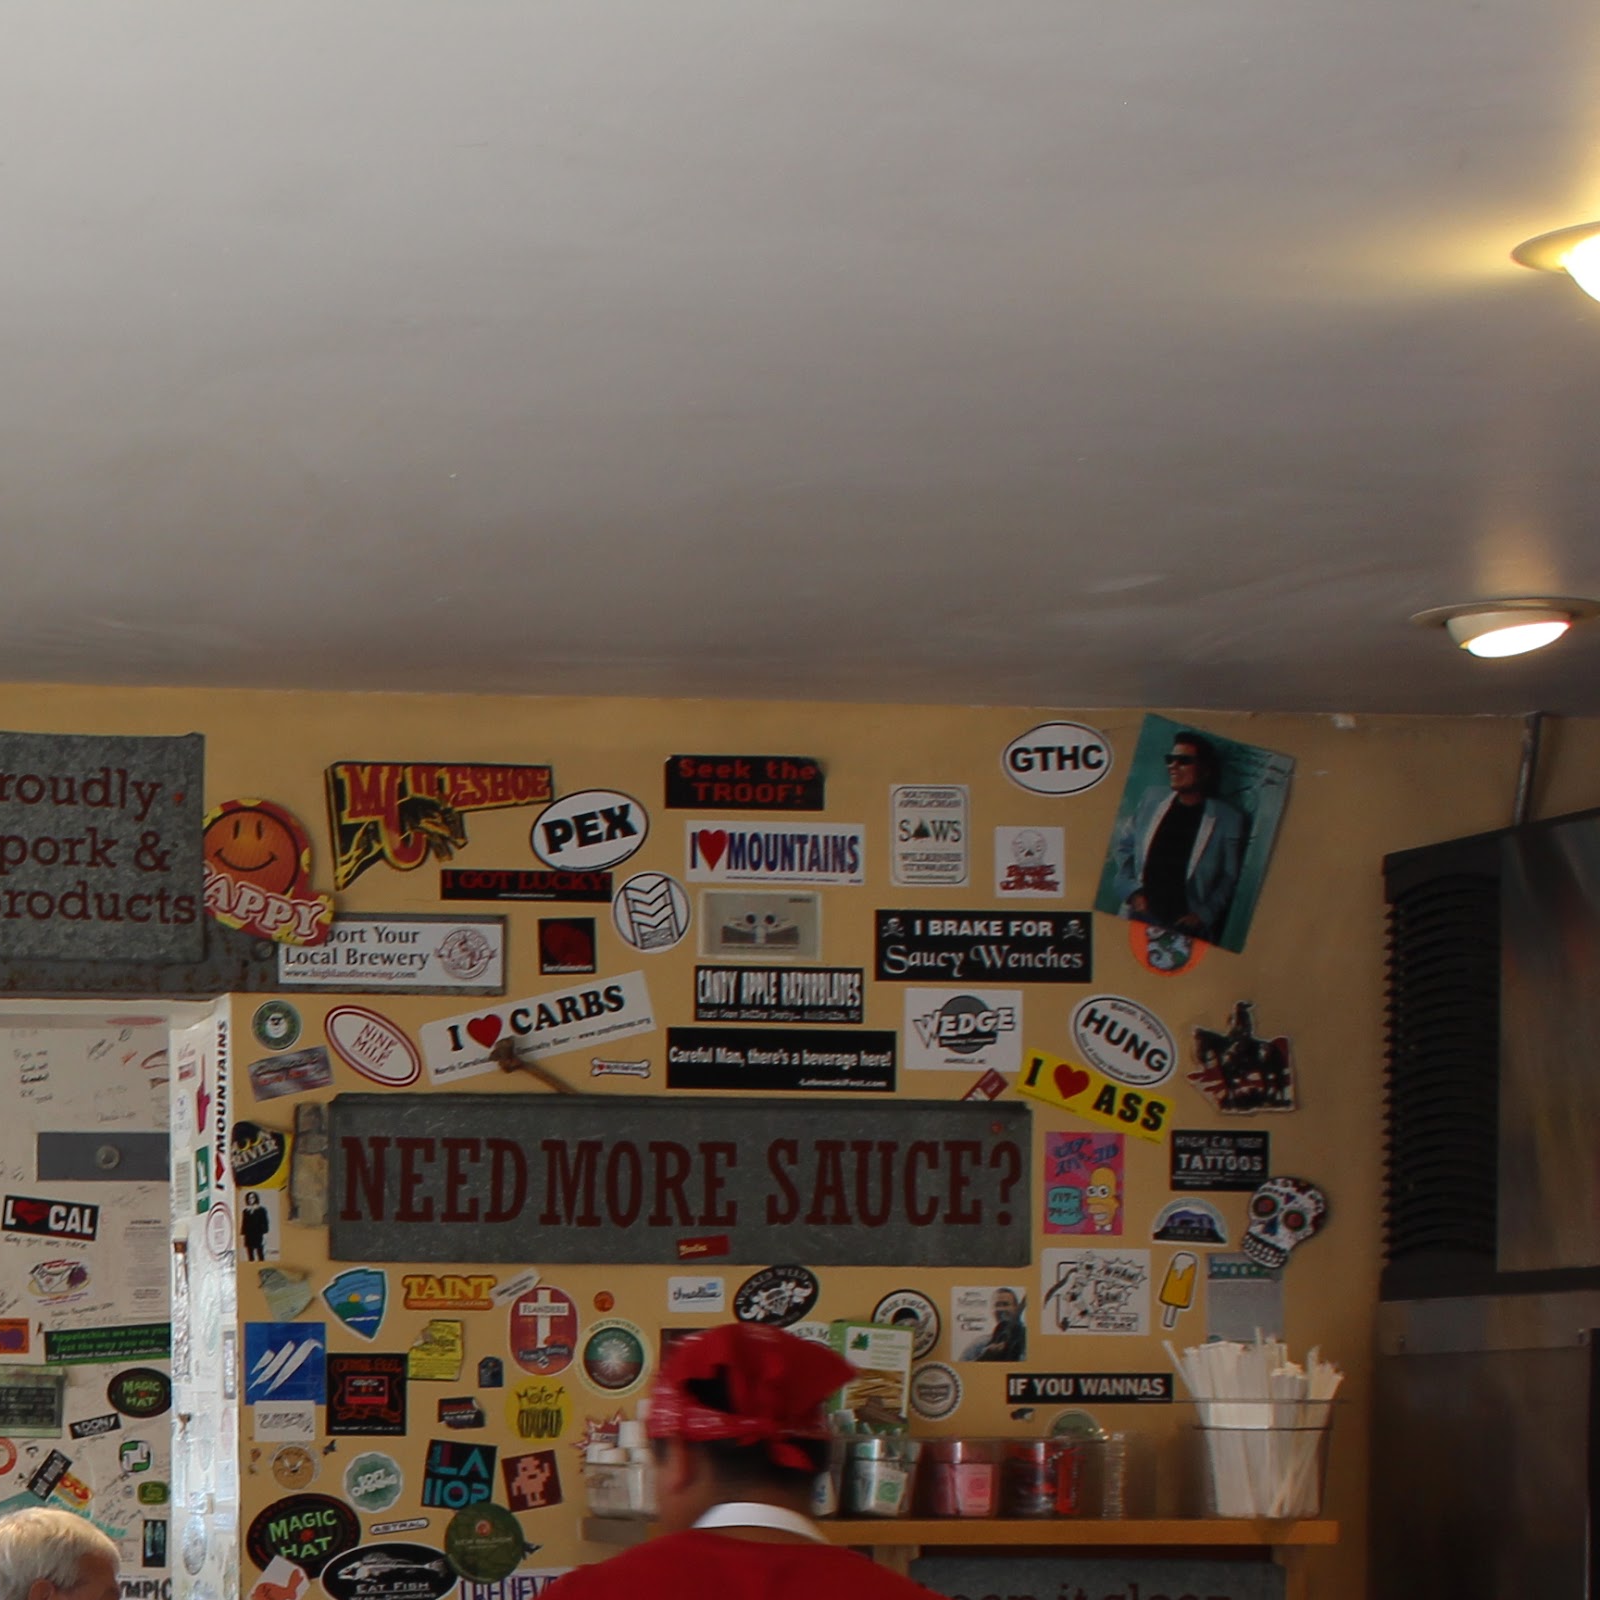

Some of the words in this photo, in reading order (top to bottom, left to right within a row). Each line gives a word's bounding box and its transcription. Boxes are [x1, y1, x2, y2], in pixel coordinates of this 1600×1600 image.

[679, 757, 750, 780] Seek
[765, 760, 820, 782] the
[1009, 744, 1105, 773] GTHC
[690, 781, 805, 804] TROOF!
[541, 803, 639, 855] PEX
[133, 830, 172, 873] &
[690, 832, 699, 870] I
[726, 830, 860, 875] MOUNTAINS
[444, 872, 455, 889] I
[459, 871, 514, 889] GOT
[202, 862, 328, 940] APPY
[373, 926, 420, 945] Your
[913, 919, 923, 936] I
[928, 919, 1004, 937] BRAKE
[1009, 920, 1054, 937] FOR
[284, 947, 338, 967] Local
[345, 947, 431, 970] Brewery
[882, 944, 964, 978] Saucy
[969, 944, 1084, 970] Wenches
[446, 1024, 465, 1052] I
[509, 984, 626, 1036] CARBS
[912, 1006, 1016, 1049] WEDGE
[360, 1021, 399, 1053] NINE
[1079, 1007, 1170, 1073] HUNG
[351, 1035, 393, 1068] MILE
[668, 1045, 714, 1064] Careful
[715, 1046, 745, 1067] Man,
[747, 1048, 789, 1065] there's
[791, 1052, 800, 1065] a
[801, 1049, 858, 1071] beverage
[860, 1050, 892, 1068] here!
[213, 1019, 229, 1155] MOUNTAINS
[1024, 1056, 1044, 1087] I
[1093, 1082, 1166, 1133] ASS
[1178, 1153, 1263, 1171] TATTOOS
[339, 1135, 529, 1226] NEED
[540, 1138, 738, 1229] MORE
[765, 1136, 1023, 1229] SAUCE?
[403, 1276, 497, 1300] TAINT
[122, 1380, 160, 1394] MAGIC
[1009, 1377, 1029, 1397] IF
[1032, 1377, 1075, 1397] YOU
[1079, 1376, 1167, 1397] WANNAS
[125, 1396, 155, 1408] HAT
[268, 1509, 338, 1543] MAGIC
[372, 1519, 428, 1534] ASTRAL
[278, 1535, 333, 1560] HAT
[356, 1583, 387, 1594] EAT
[392, 1580, 431, 1592] FISH
